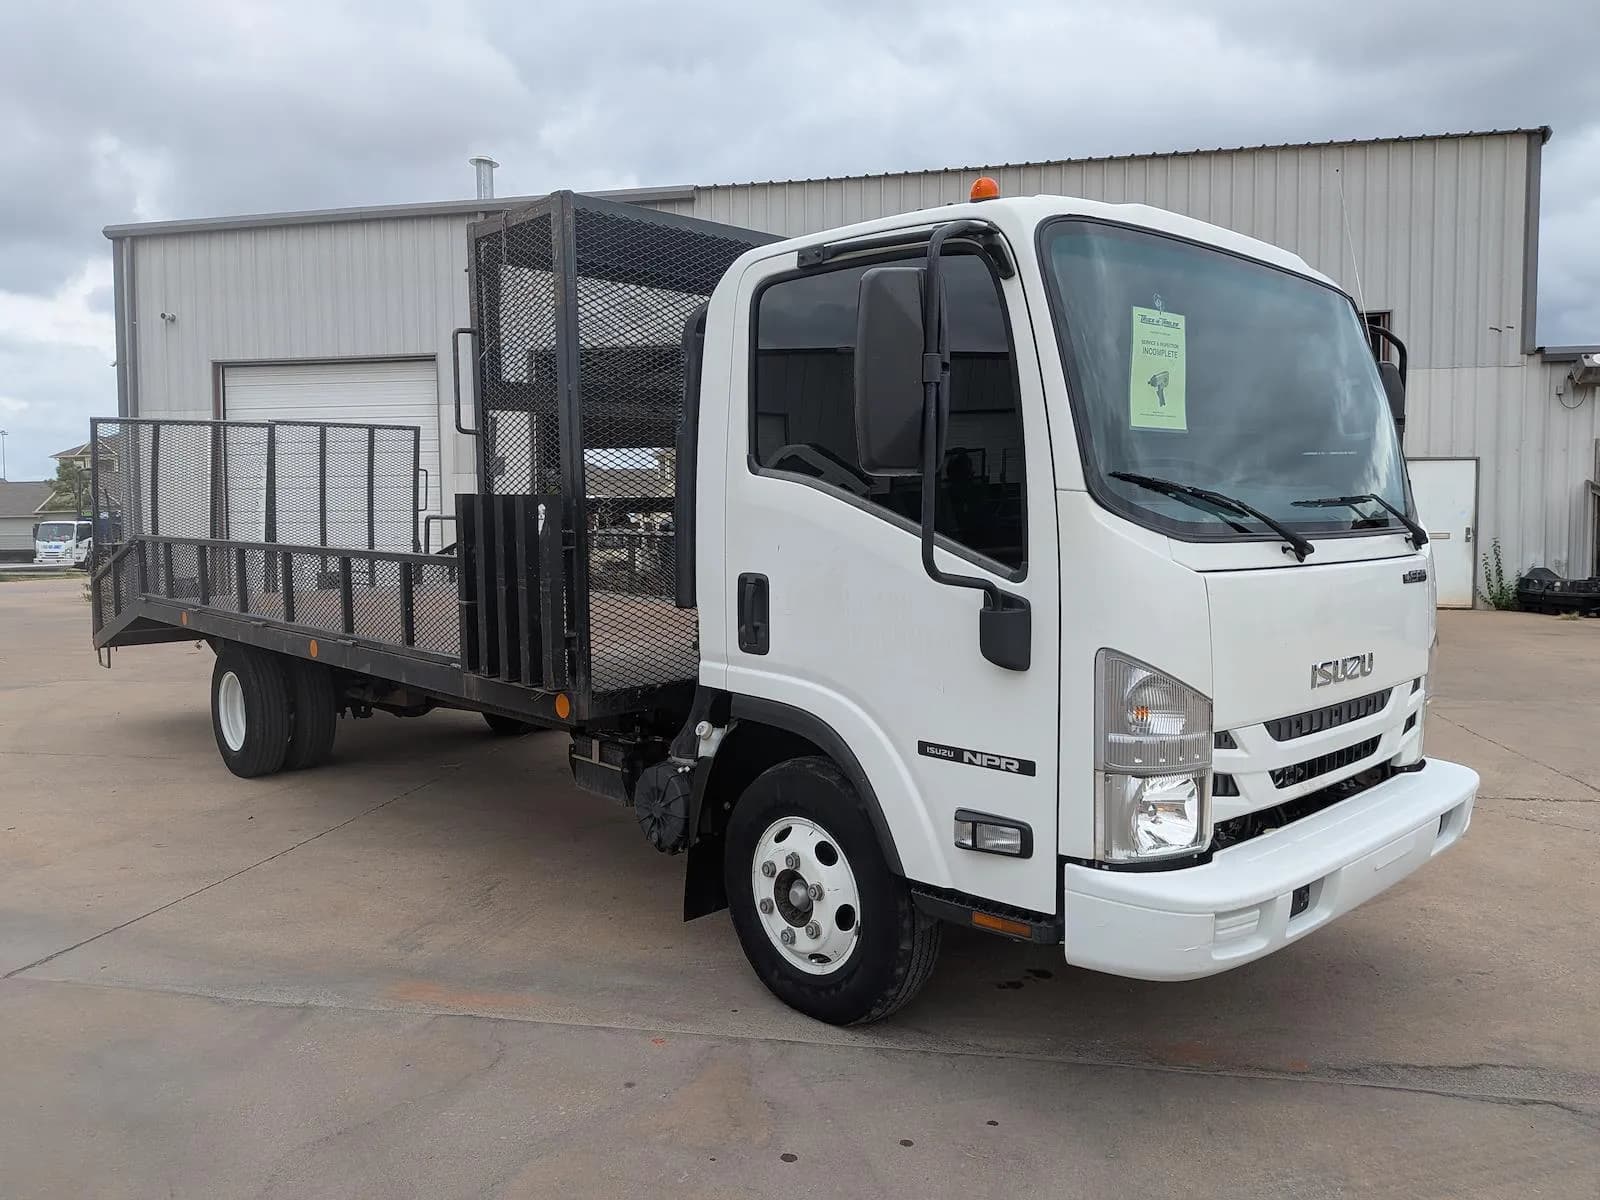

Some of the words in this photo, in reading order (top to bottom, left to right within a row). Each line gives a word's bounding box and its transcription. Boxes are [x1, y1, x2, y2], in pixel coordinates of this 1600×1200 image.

[1142, 346, 1178, 359] INCOMPLETE
[1311, 652, 1374, 690] ISUZU
[926, 746, 954, 758] ISUZU
[963, 751, 1020, 773] NPR
